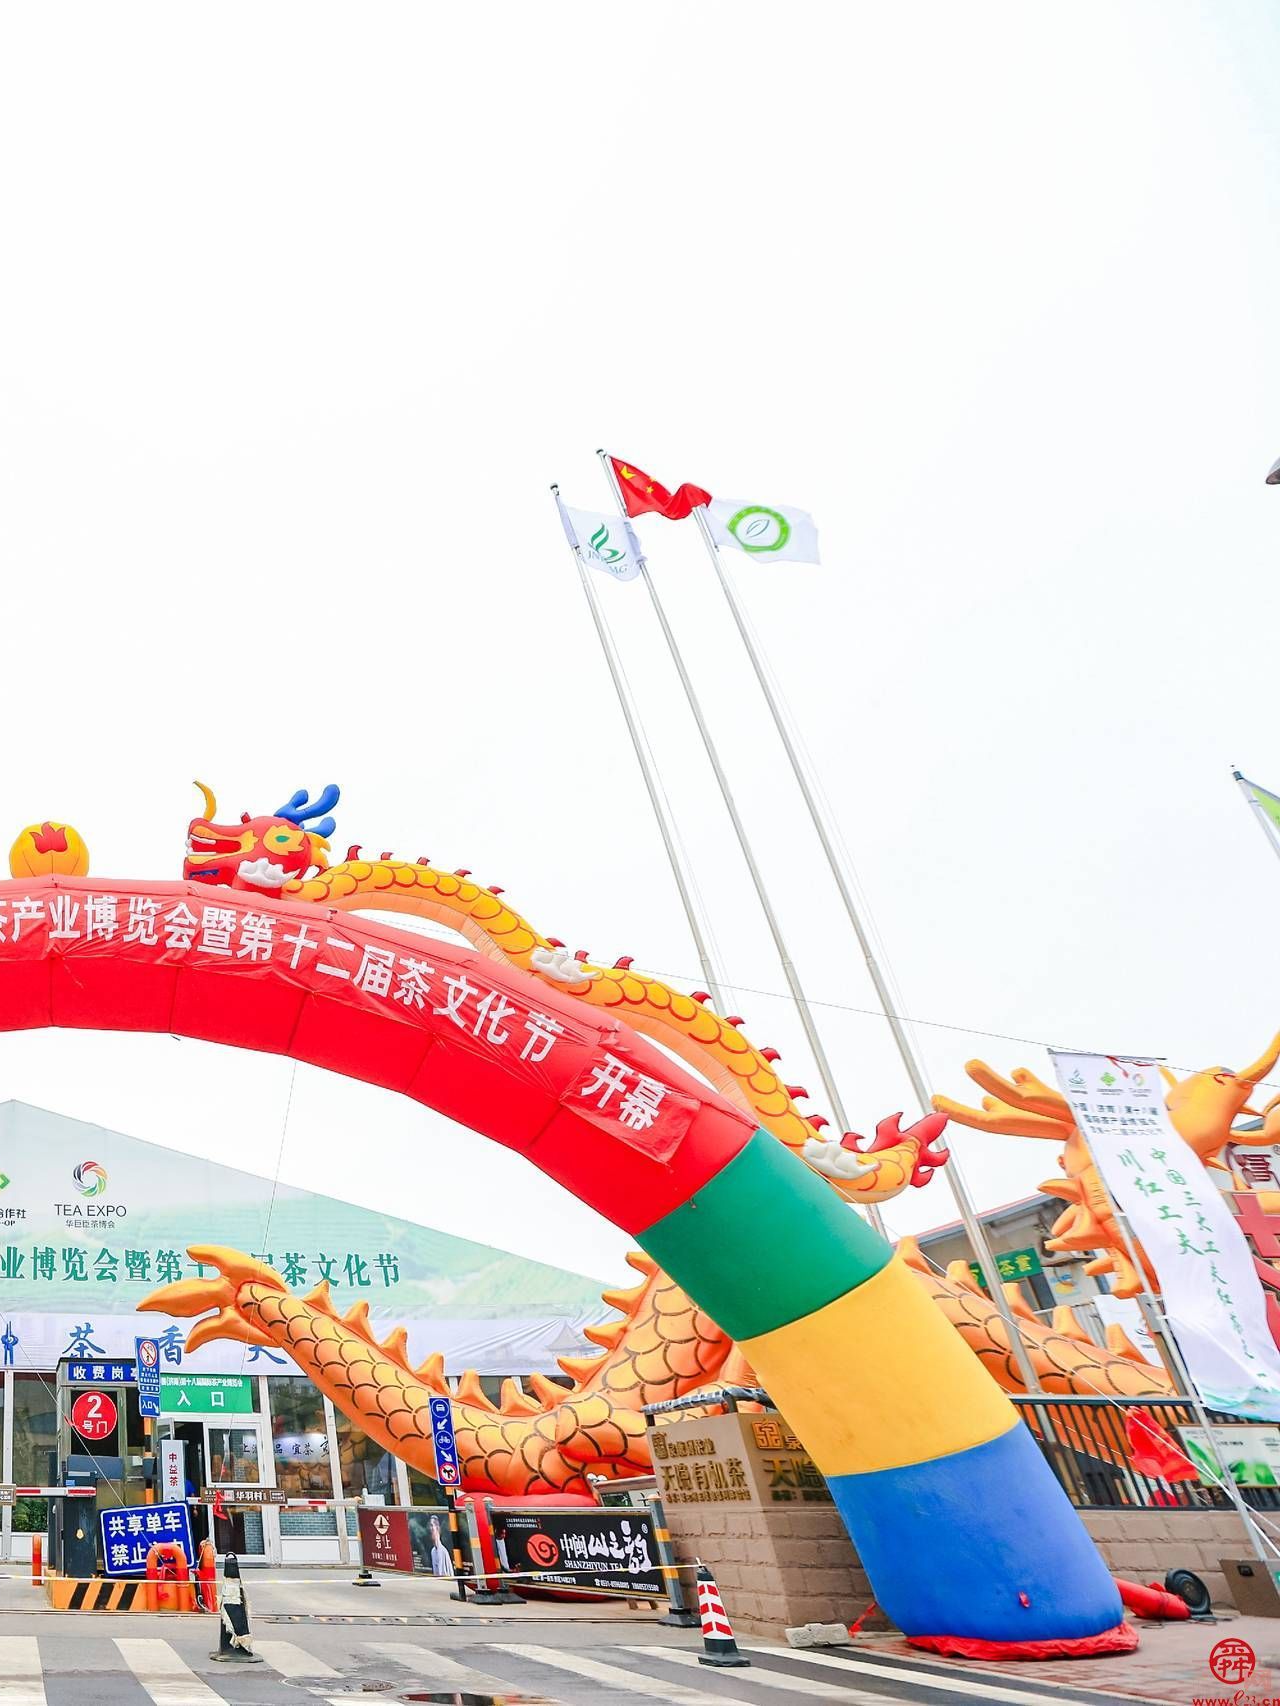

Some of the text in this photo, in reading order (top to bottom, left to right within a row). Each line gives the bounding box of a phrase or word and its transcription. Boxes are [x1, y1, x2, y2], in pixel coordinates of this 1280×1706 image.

[580, 1052, 673, 1133] 开幕
[54, 1203, 127, 1218] TEA EXPO
[87, 1395, 103, 1419] 2
[141, 1399, 153, 1409] 入口
[176, 1389, 225, 1407] 入口
[81, 1420, 108, 1434] 号门
[108, 1510, 182, 1538] 共享单车
